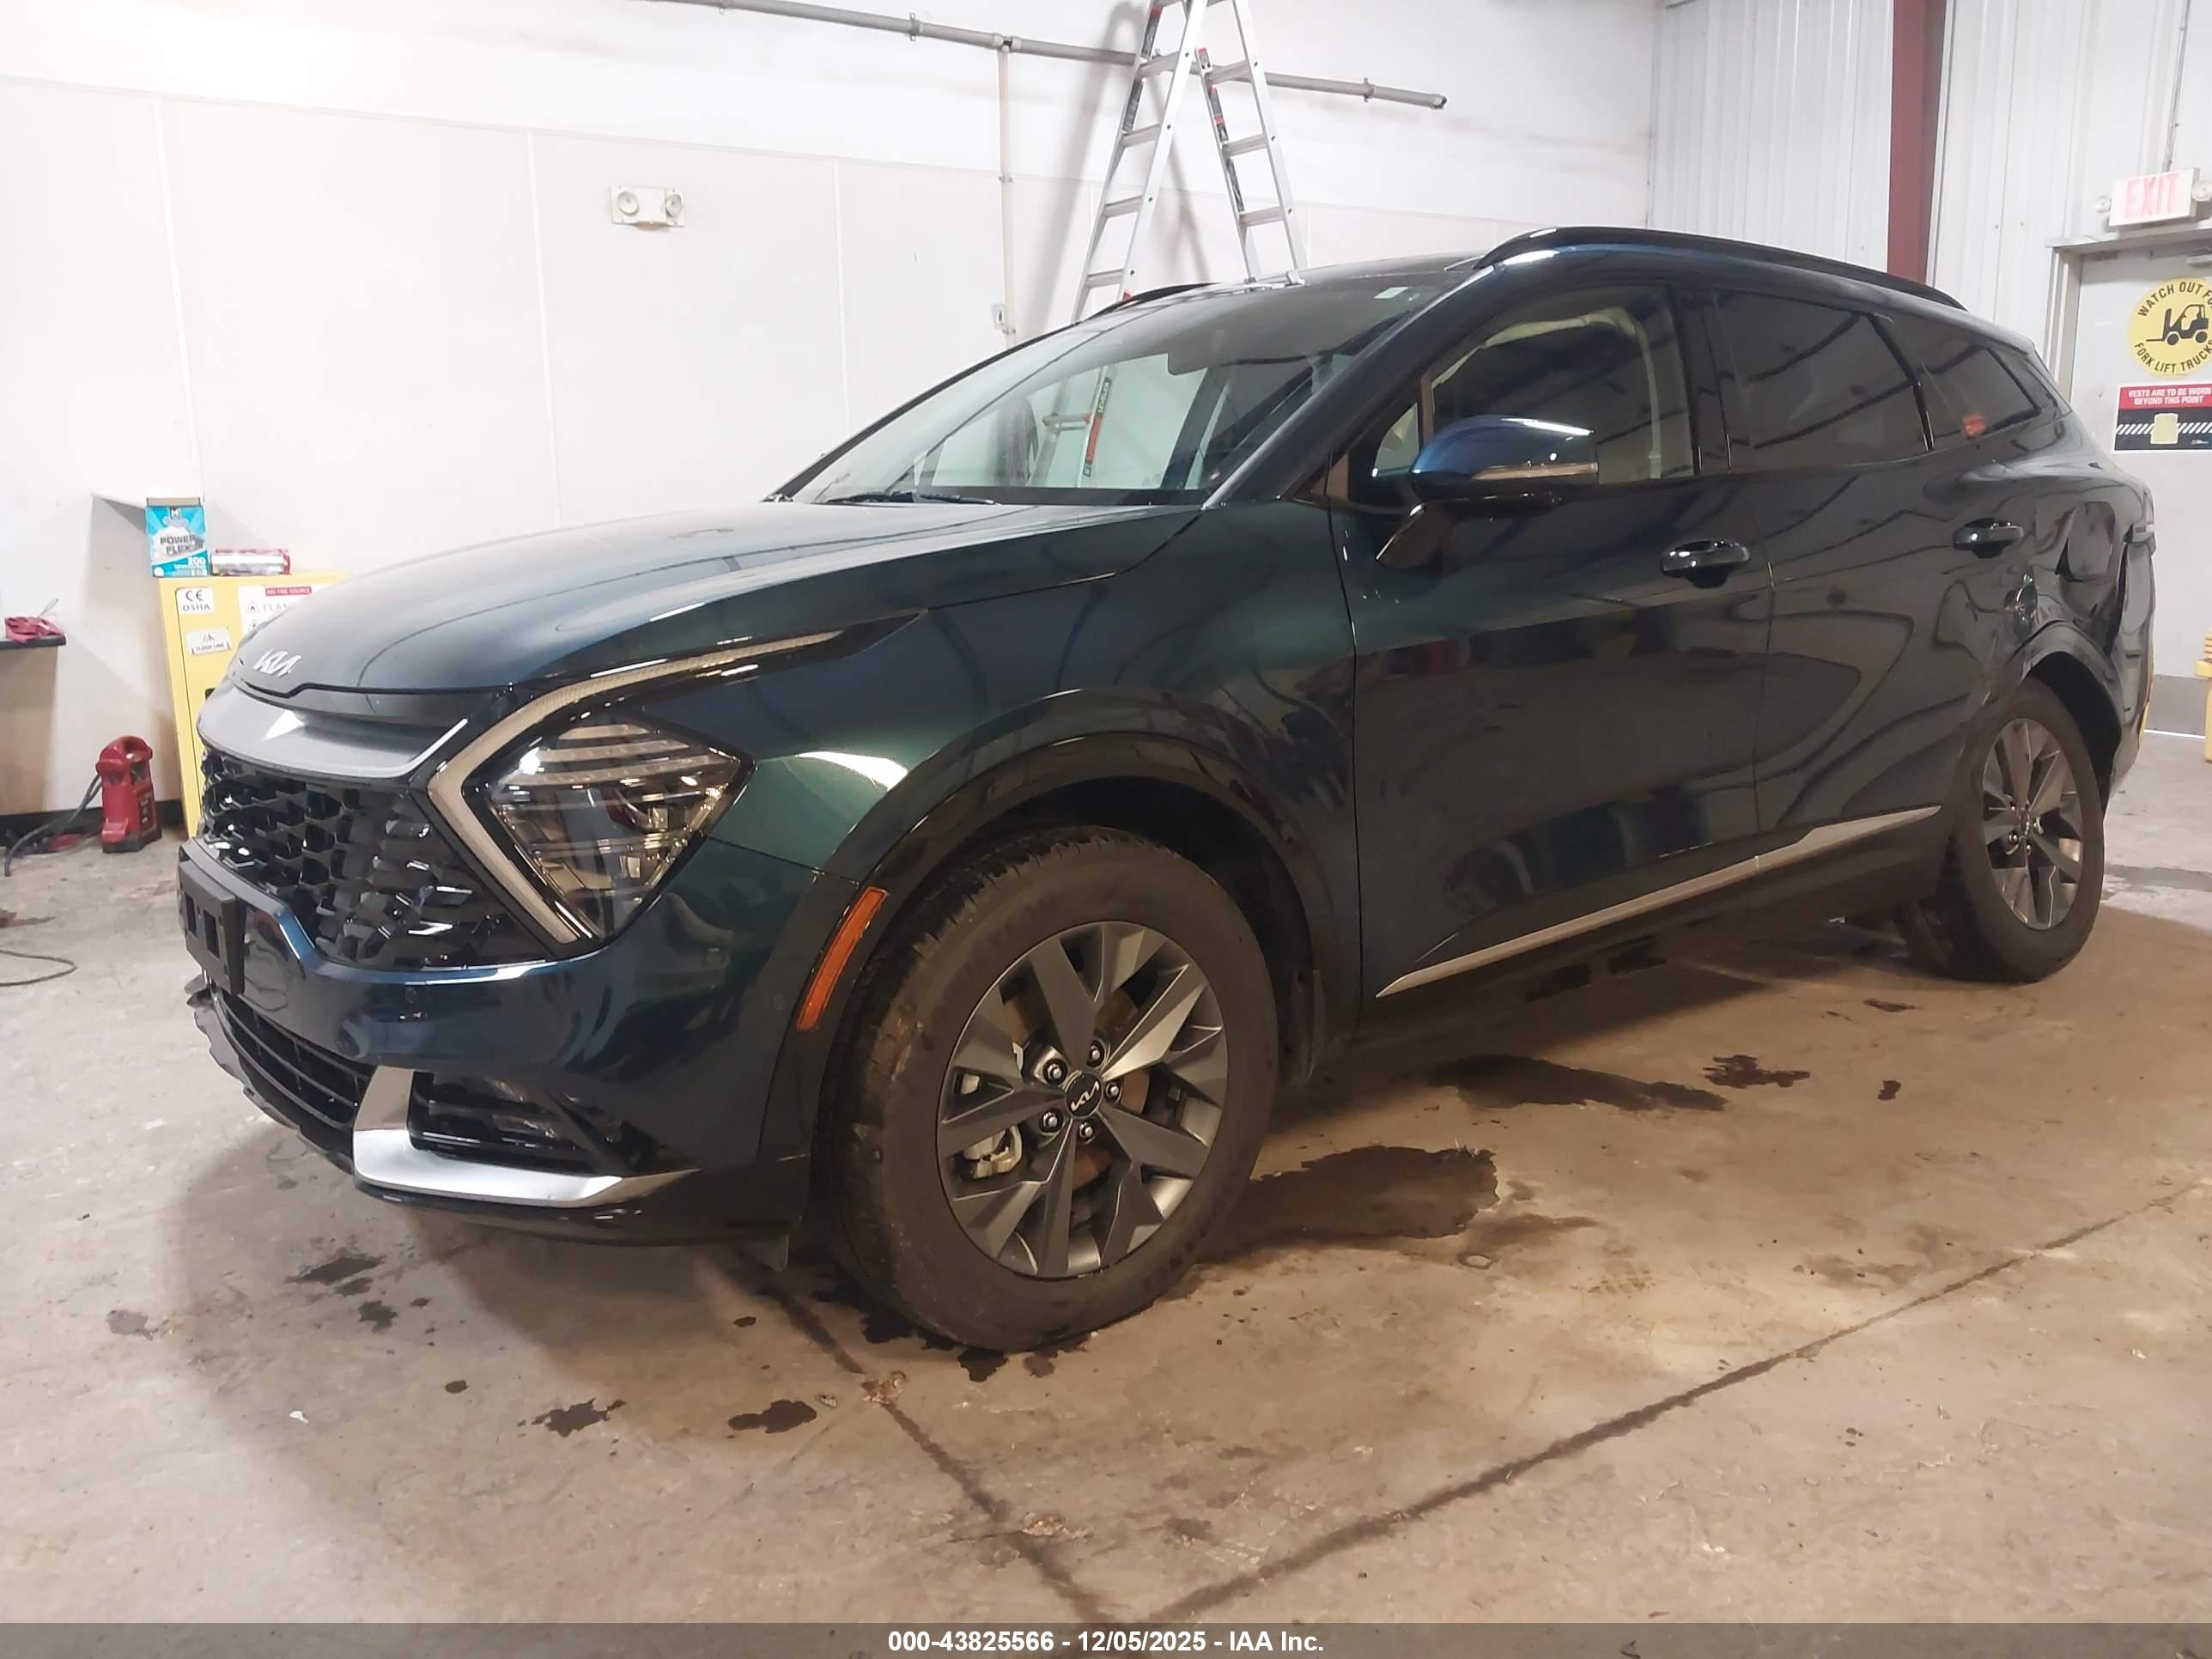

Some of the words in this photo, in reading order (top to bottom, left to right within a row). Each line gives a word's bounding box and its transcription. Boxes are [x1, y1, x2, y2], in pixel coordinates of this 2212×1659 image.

[2124, 173, 2179, 219] EXIT
[2137, 283, 2174, 317] WATCH
[2179, 282, 2203, 295] OUT
[2134, 343, 2155, 368] FORK
[2154, 361, 2177, 374] LIFT
[2129, 389, 2150, 398] VESTS
[2151, 388, 2166, 397] ARE
[2188, 386, 2212, 395] WORN
[2134, 397, 2163, 405] BEYOND
[2164, 396, 2181, 404] THIS
[2181, 395, 2204, 404] POINT
[160, 534, 196, 544] POWER
[166, 544, 191, 556] FLEX
[185, 589, 204, 602] CE
[253, 649, 301, 678] KIA
